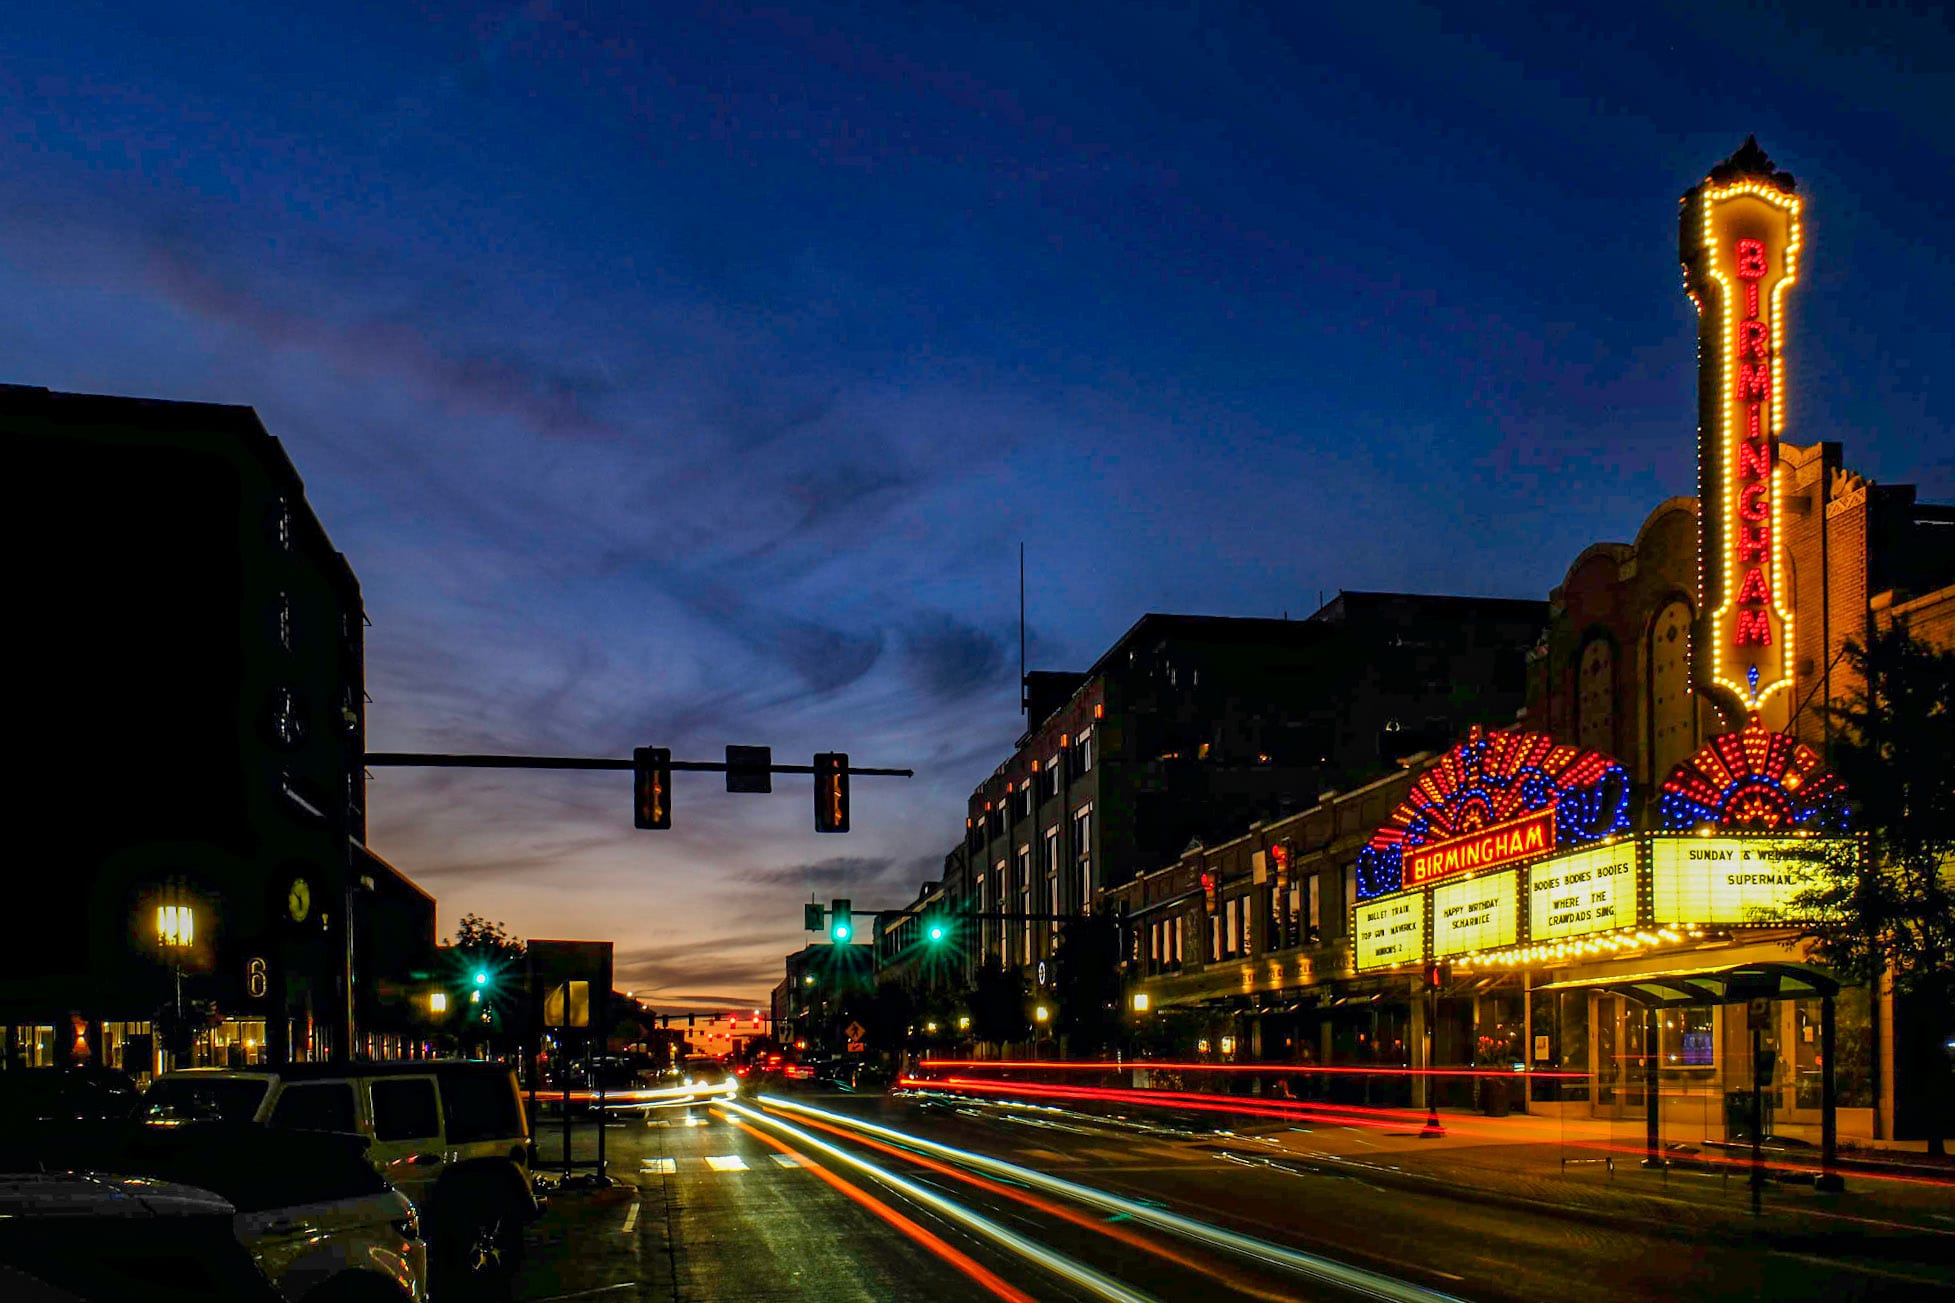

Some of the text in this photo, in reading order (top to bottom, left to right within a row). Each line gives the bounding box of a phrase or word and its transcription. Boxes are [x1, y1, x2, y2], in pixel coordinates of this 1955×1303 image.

[1735, 238, 1773, 647] BIRMINGHAM
[1414, 827, 1544, 880] BIRMINGHAM
[1689, 849, 1734, 861] SUNDAY
[1743, 850, 1751, 861] &
[1533, 862, 1629, 892] BODIES BODIES BODIES
[1727, 874, 1791, 885] SUPERMAN
[1443, 898, 1499, 918] HAPPY BIRTHDAY
[1552, 891, 1607, 910] WHERE THE
[1367, 905, 1409, 922] BULLET TRAIN
[1548, 905, 1615, 927] CRAWDADS SING
[1361, 931, 1372, 941] TOP
[1390, 922, 1417, 935] MAVERICK
[248, 957, 267, 998] 6
